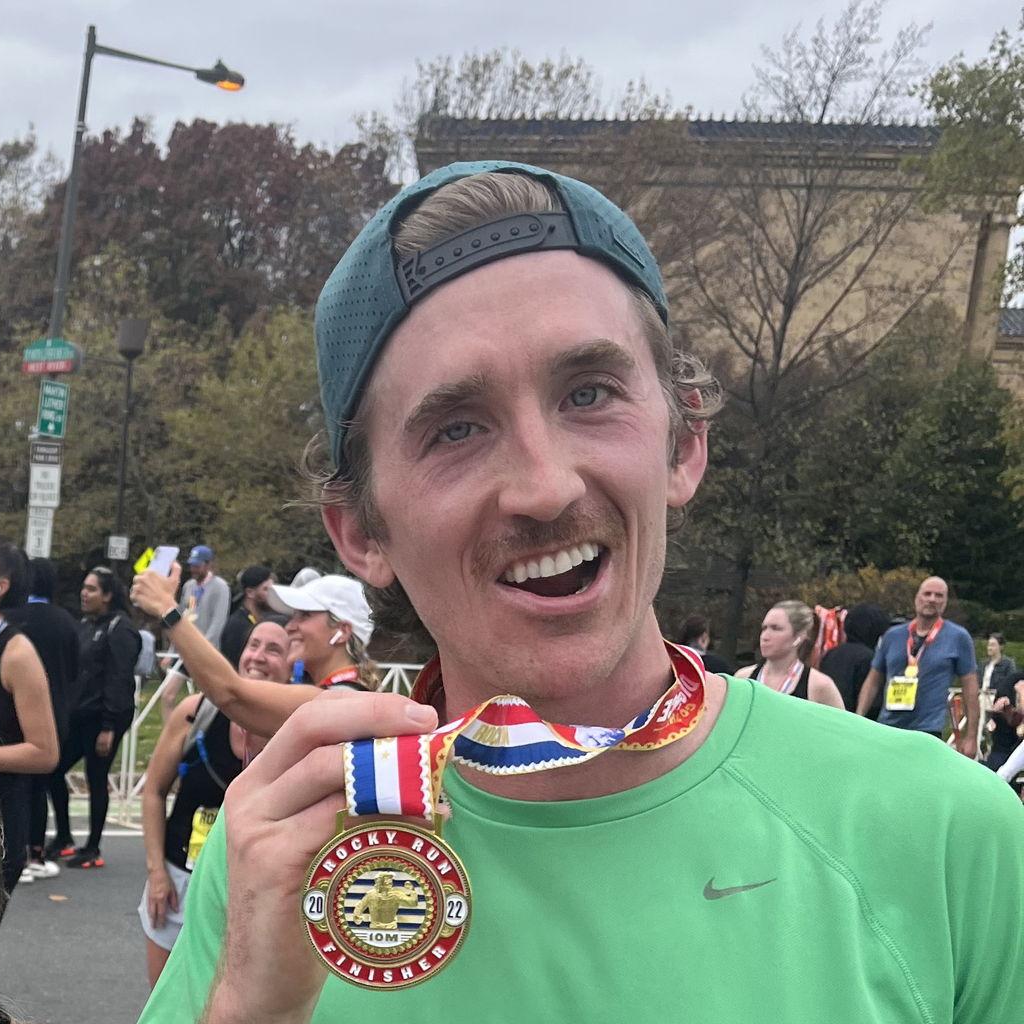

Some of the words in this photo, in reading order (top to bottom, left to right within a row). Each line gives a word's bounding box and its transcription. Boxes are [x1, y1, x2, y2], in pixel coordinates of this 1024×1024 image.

[322, 831, 397, 873] ROCKY
[411, 838, 453, 875] RUN
[309, 895, 323, 914] 20
[447, 900, 463, 919] 22
[322, 942, 446, 982] FINISHER
